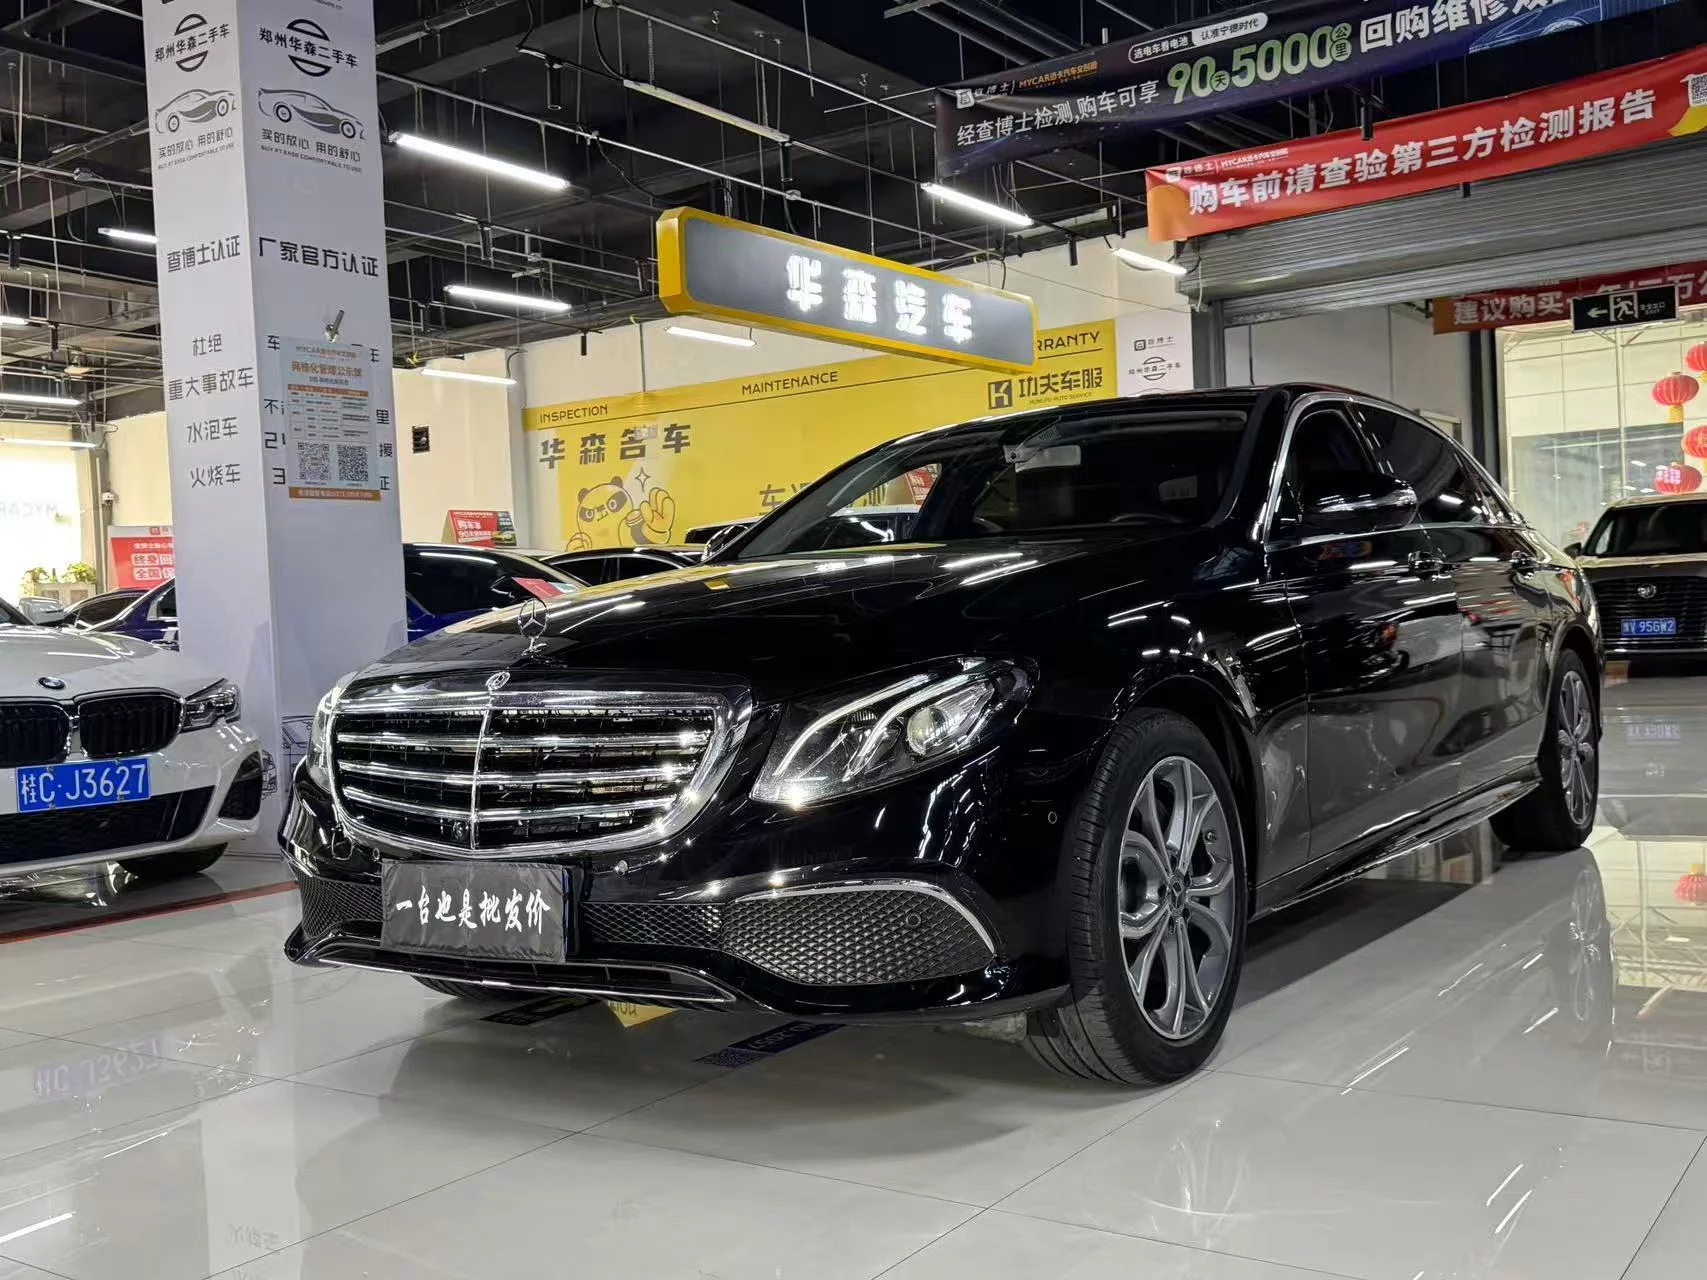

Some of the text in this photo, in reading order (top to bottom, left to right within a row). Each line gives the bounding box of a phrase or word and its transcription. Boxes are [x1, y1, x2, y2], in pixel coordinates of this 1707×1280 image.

[154, 23, 230, 63] 郑州华森二手车
[259, 27, 359, 69] 郑州华森二手车
[1133, 18, 1259, 60] 选电车看电池 认准宁德时代
[956, 80, 1160, 147] 经查博士检测,购车可享
[1188, 88, 1657, 216] 购车前请查验第三方检测报告
[167, 234, 241, 273] 查博士认证
[259, 236, 379, 277] 厂家官方认证
[786, 254, 973, 344] 华森汽车
[1453, 290, 1565, 326] 建议购买
[192, 333, 222, 356] 杜绝
[1038, 331, 1100, 351] RRANTY
[168, 367, 254, 401] 重大事故车
[742, 371, 839, 395] MAINTENANCE
[1018, 367, 1103, 397] 功夫车服
[187, 417, 239, 443] 水泡车
[539, 405, 608, 423] INSPECTION
[190, 464, 241, 489] 火烧车
[21, 764, 146, 805] 桂C·J3627
[396, 885, 551, 935] 一台也是批发价
